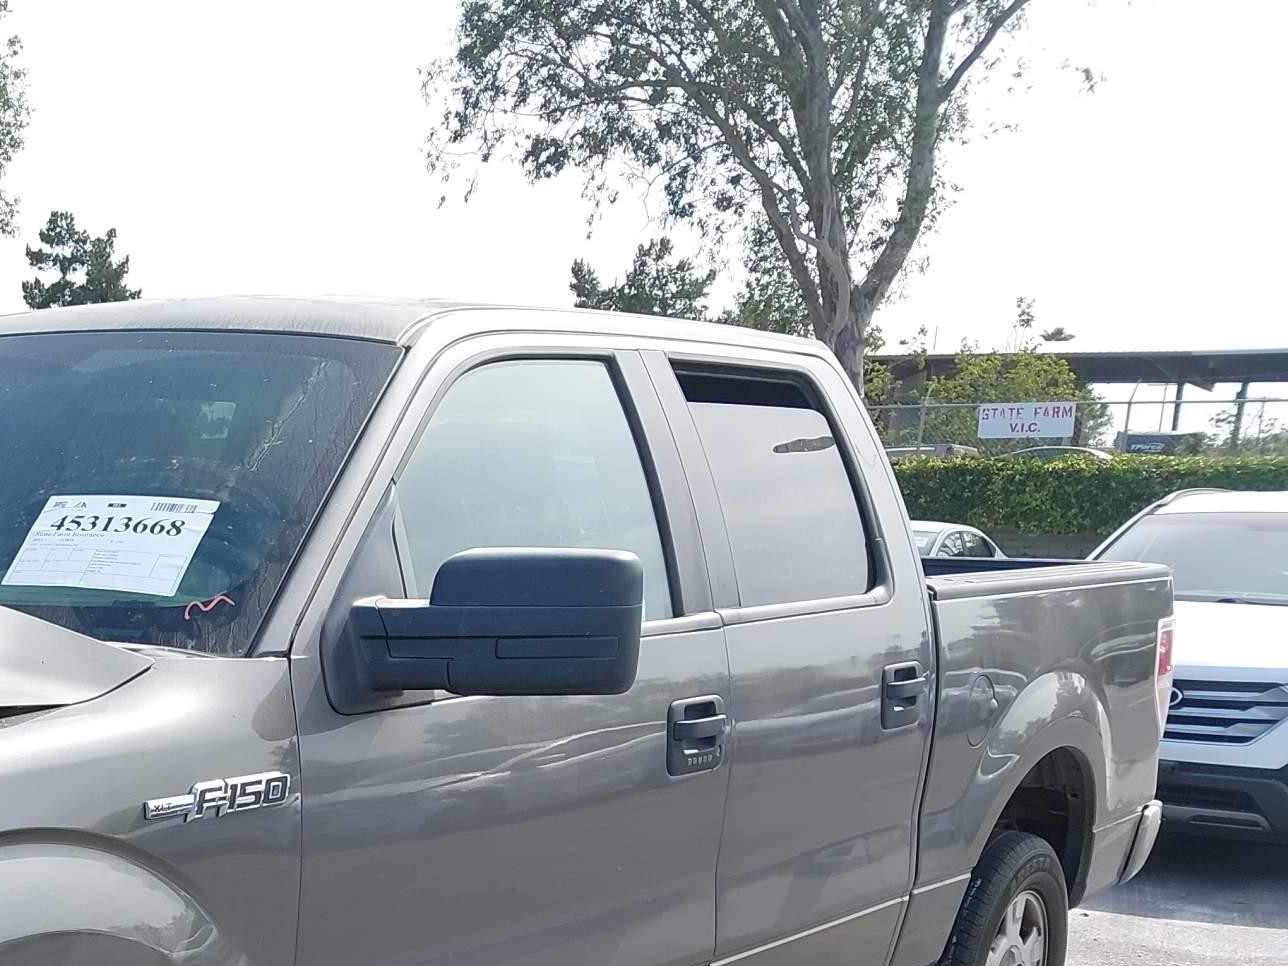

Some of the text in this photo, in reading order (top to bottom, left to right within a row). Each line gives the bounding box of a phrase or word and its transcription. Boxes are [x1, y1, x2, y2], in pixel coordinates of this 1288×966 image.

[982, 405, 1073, 420] STATE FARM
[1009, 422, 1041, 433] V.I.C.
[50, 514, 186, 537] 45313668
